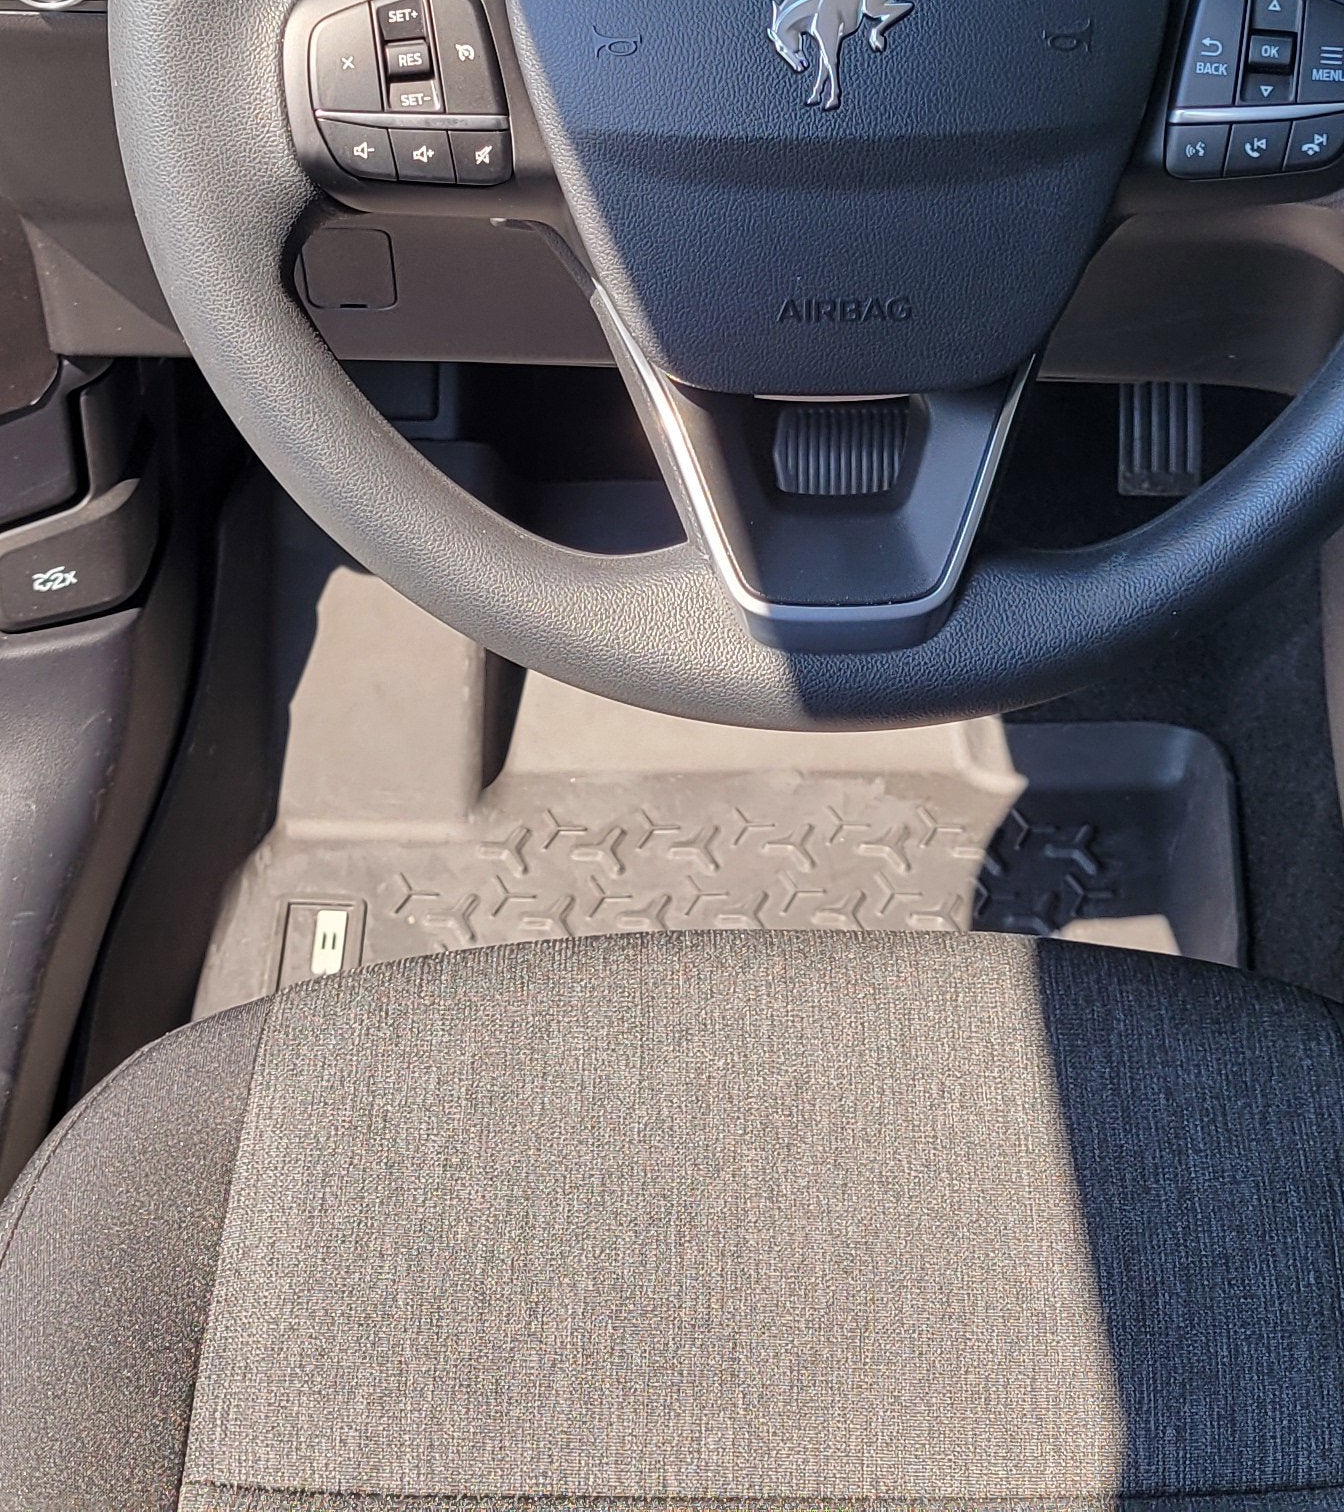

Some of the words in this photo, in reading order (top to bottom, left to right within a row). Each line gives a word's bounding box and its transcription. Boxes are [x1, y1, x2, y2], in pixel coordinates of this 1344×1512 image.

[387, 7, 419, 23] SET+
[1260, 44, 1279, 59] OK
[398, 53, 423, 67] RES
[1195, 60, 1228, 76] BACK
[399, 92, 432, 107] SET-
[775, 295, 914, 324] AIRBAG
